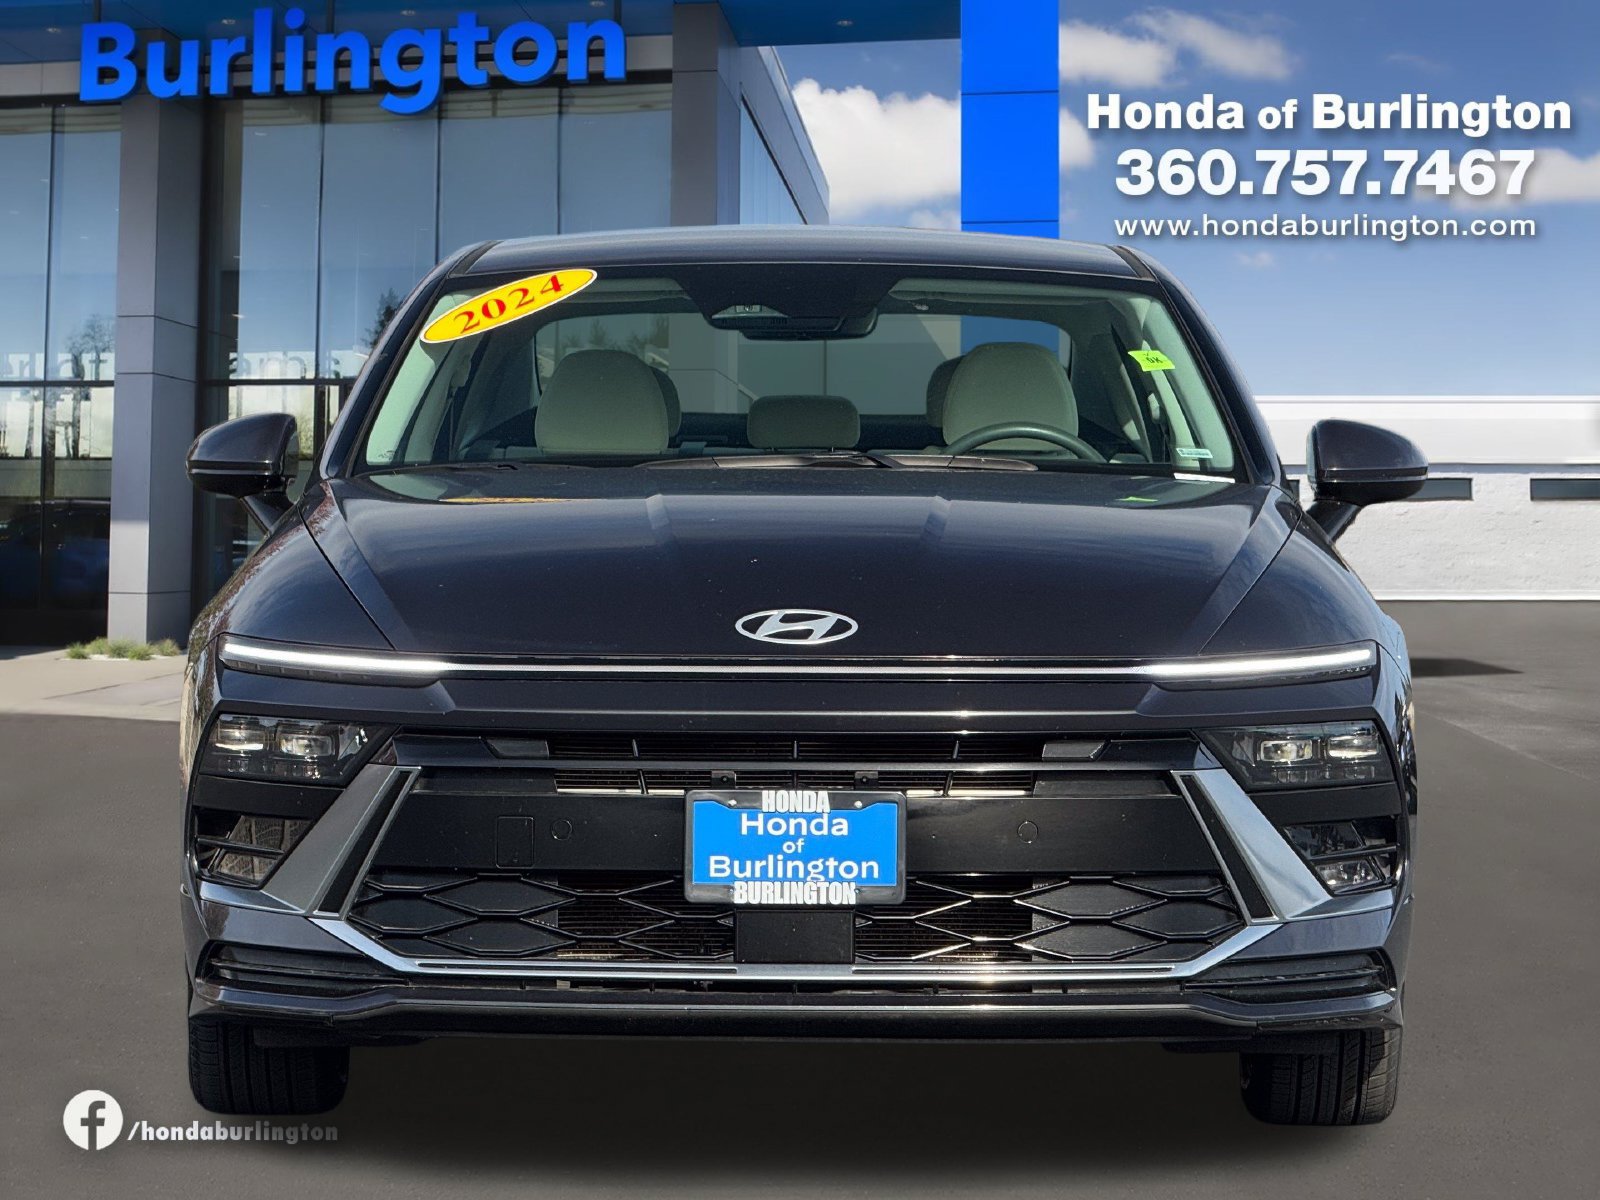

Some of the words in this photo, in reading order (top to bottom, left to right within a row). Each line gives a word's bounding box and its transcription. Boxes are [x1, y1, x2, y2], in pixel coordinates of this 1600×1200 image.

[79, 8, 627, 116] Burlington
[761, 790, 831, 814] HONDA
[741, 813, 849, 836] Honda
[782, 838, 805, 854] of
[708, 854, 879, 882] Burlington
[733, 881, 857, 905] BURLINGTON
